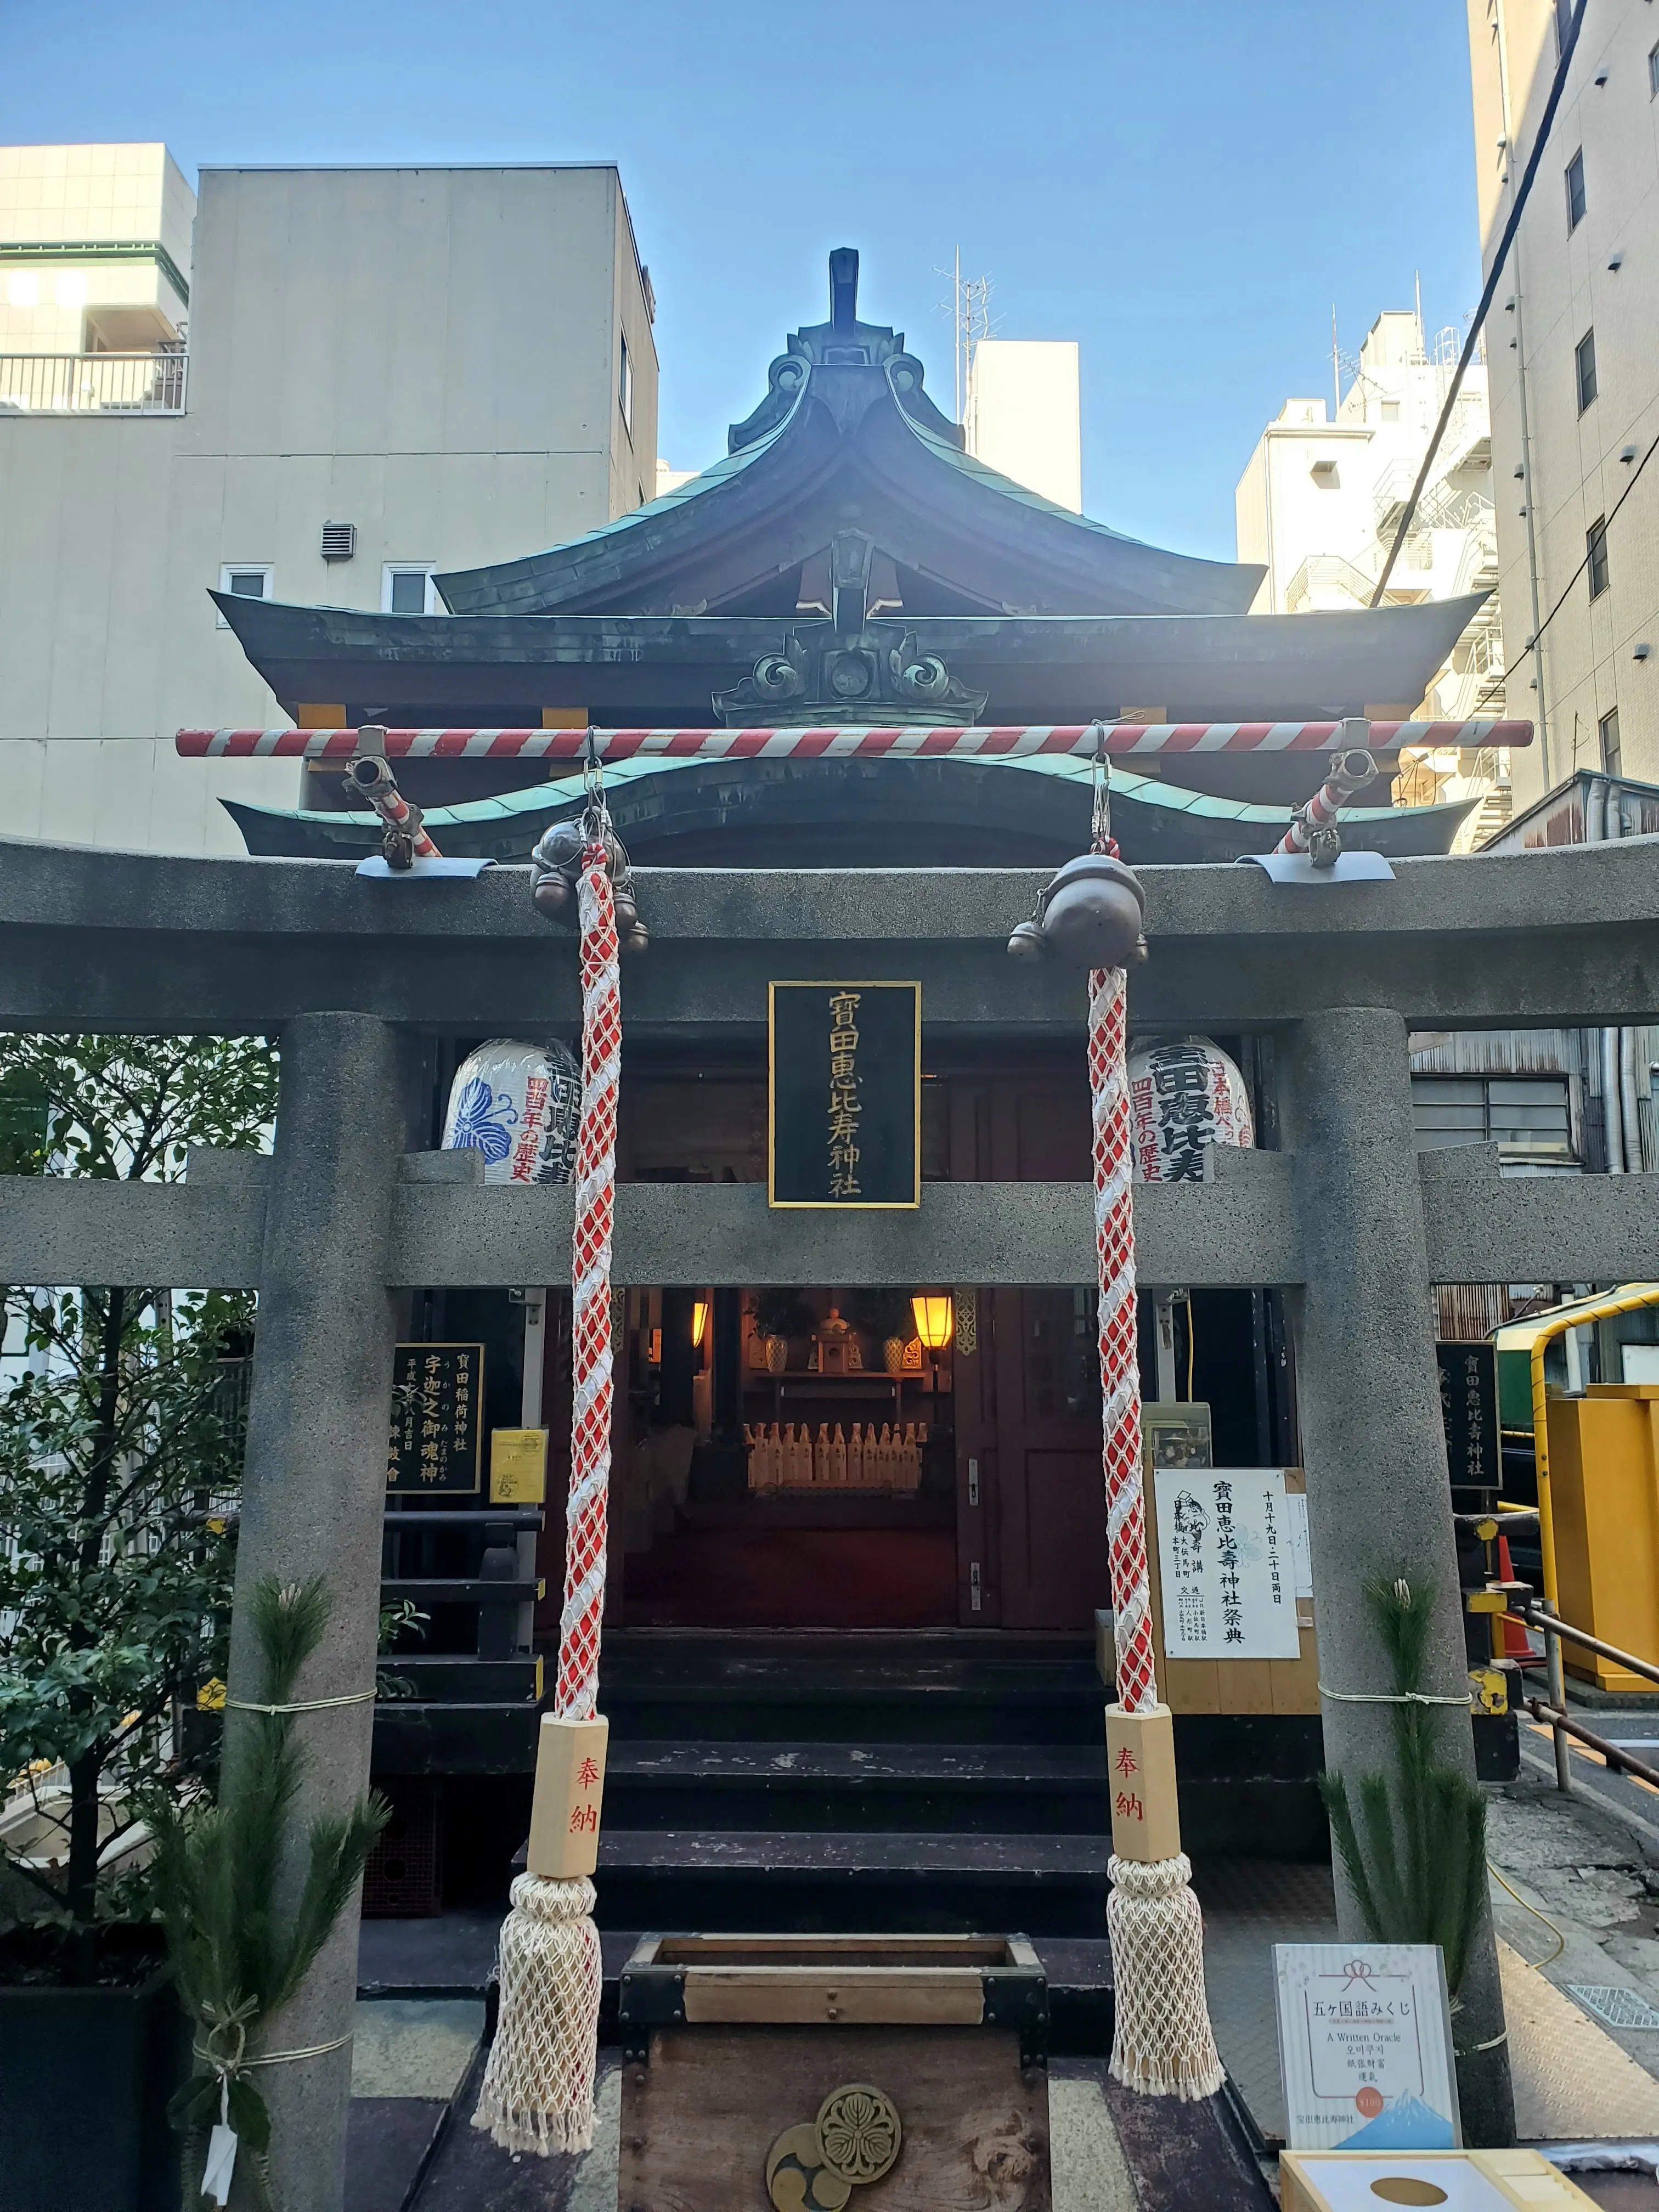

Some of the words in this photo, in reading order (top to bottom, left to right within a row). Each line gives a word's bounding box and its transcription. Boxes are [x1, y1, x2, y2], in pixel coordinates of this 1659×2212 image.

[510, 1075, 549, 1184] 四百年の歴史
[1132, 1076, 1163, 1182] 四百年の歴史
[420, 1354, 442, 1483] 宇迦之御魂神
[569, 1757, 601, 1833] 奉納
[1114, 1746, 1144, 1822] 奉納
[1327, 2033, 1334, 2042] A
[1337, 2033, 1369, 2042] Written
[1373, 2033, 1401, 2042] Oracle
